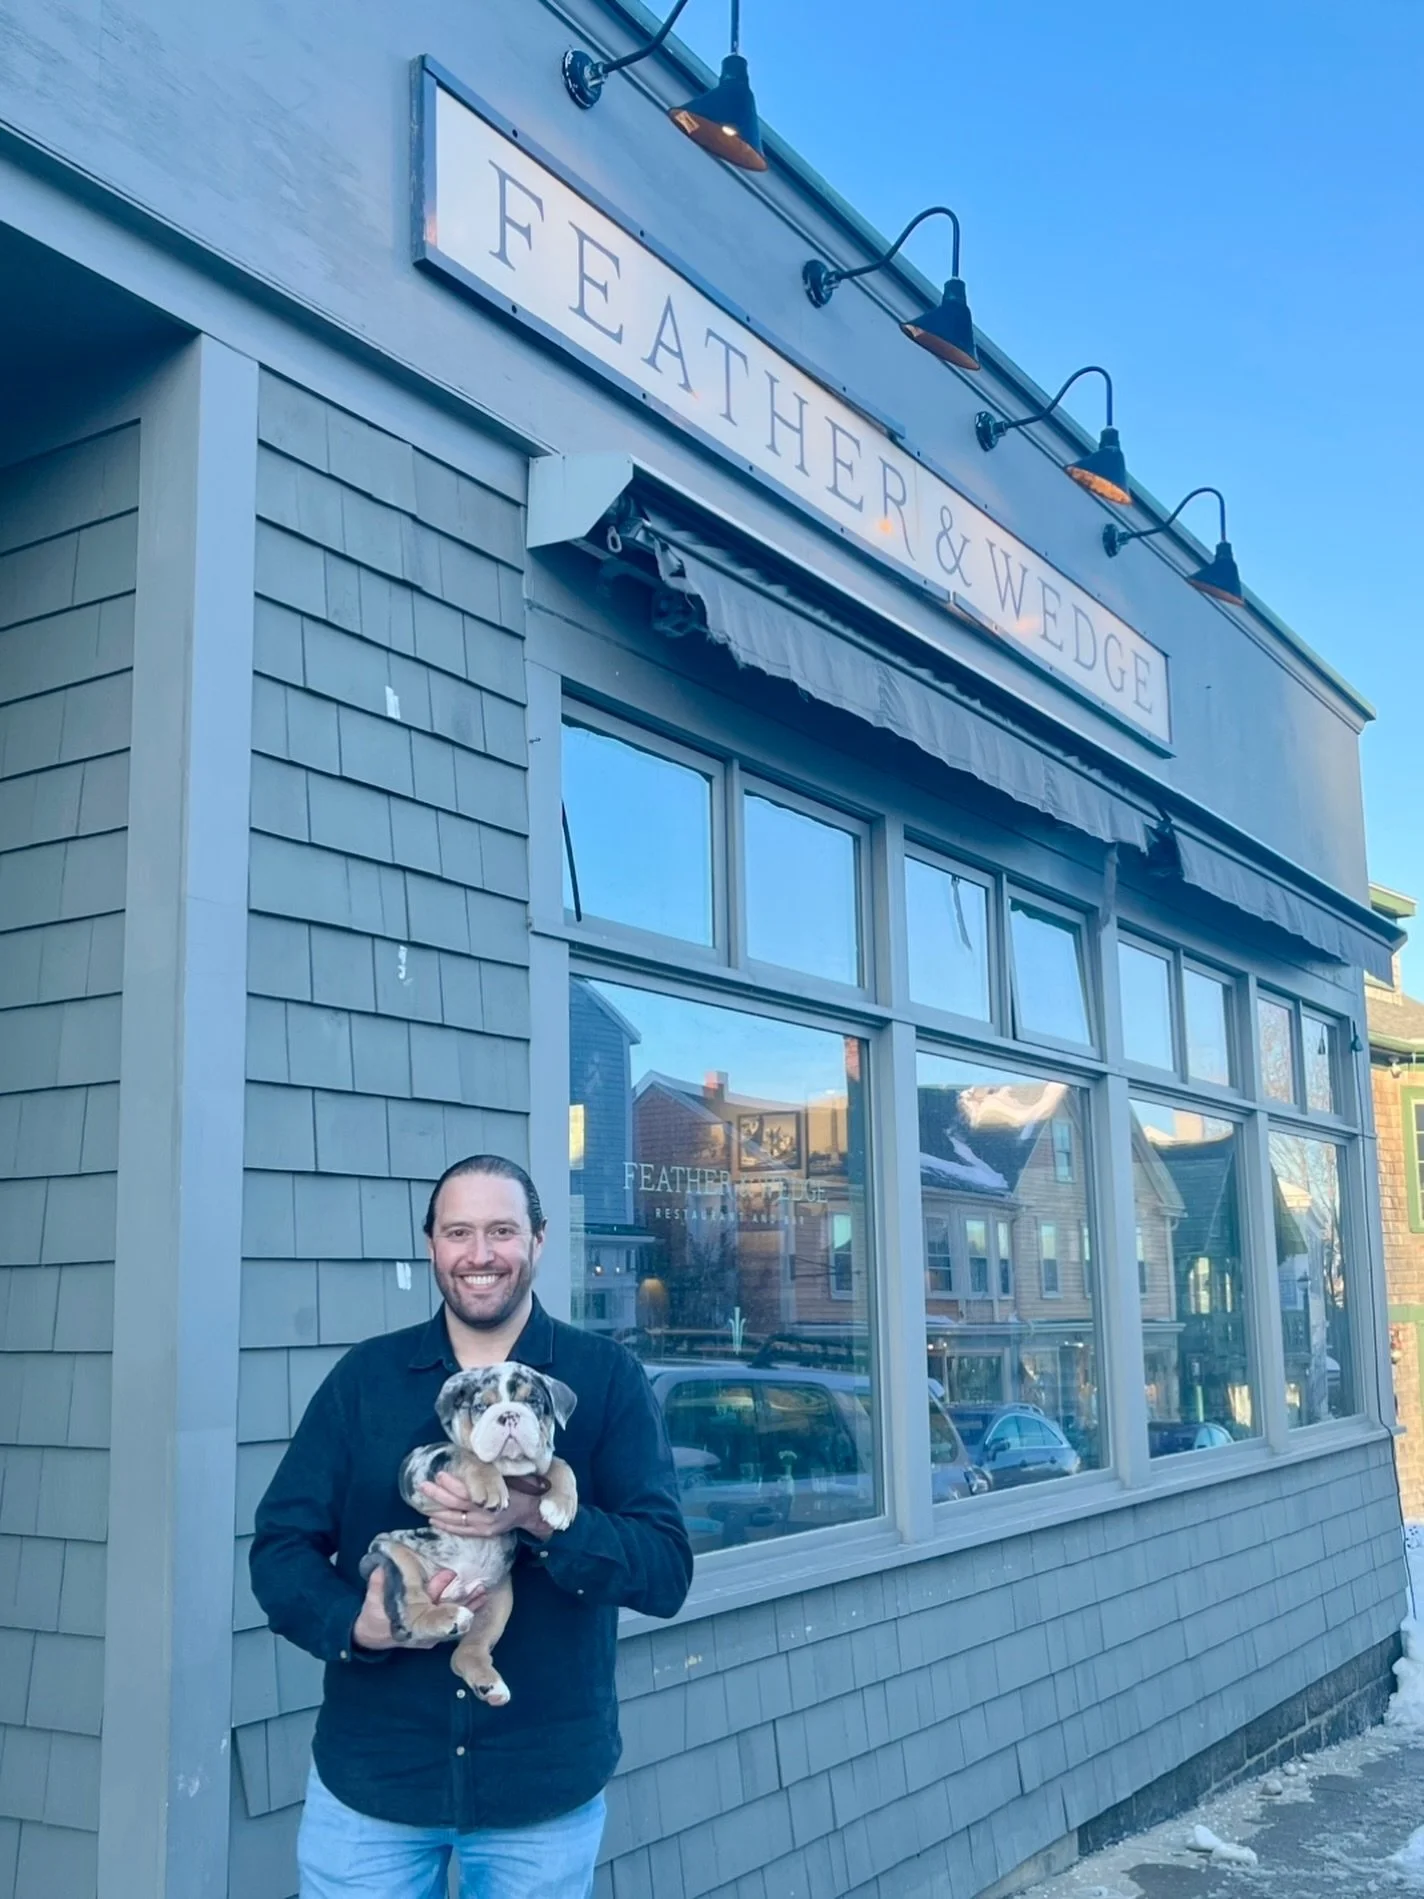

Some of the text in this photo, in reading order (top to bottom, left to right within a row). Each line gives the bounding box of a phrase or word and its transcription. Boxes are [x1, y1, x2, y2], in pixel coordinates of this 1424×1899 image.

[488, 160, 1155, 715] FEATHER & WEDGE
[623, 1162, 733, 1199] FEATHER
[759, 1177, 828, 1203] WEDGE
[656, 1207, 744, 1223] RESTAURANT
[752, 1213, 777, 1224] AND
